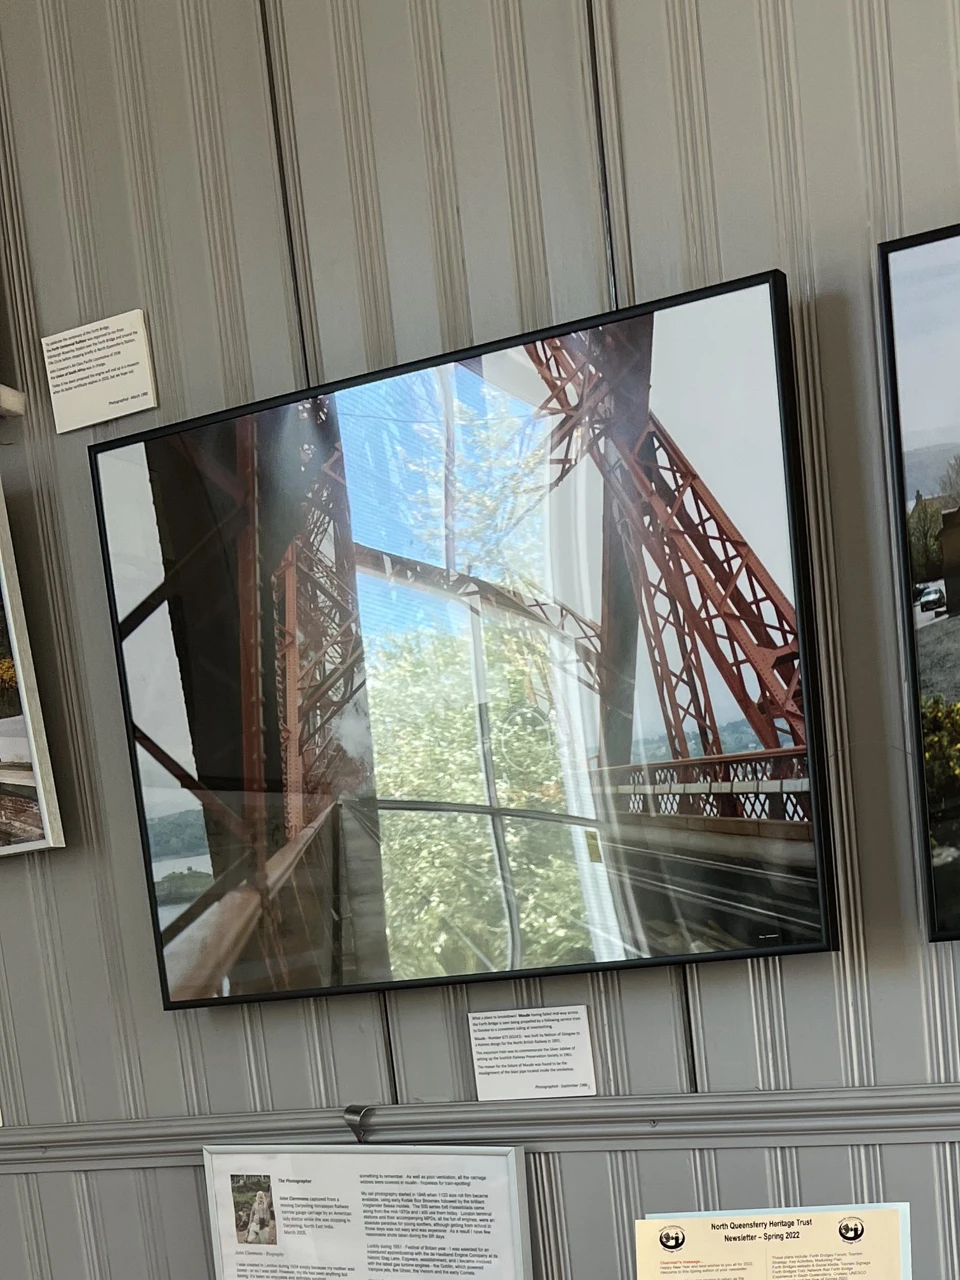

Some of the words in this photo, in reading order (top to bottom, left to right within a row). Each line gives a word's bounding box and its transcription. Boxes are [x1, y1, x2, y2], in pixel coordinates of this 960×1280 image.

[729, 1221, 767, 1229] Queensferry
[769, 1220, 794, 1228] Heritage
[763, 1232, 783, 1240] Spring
